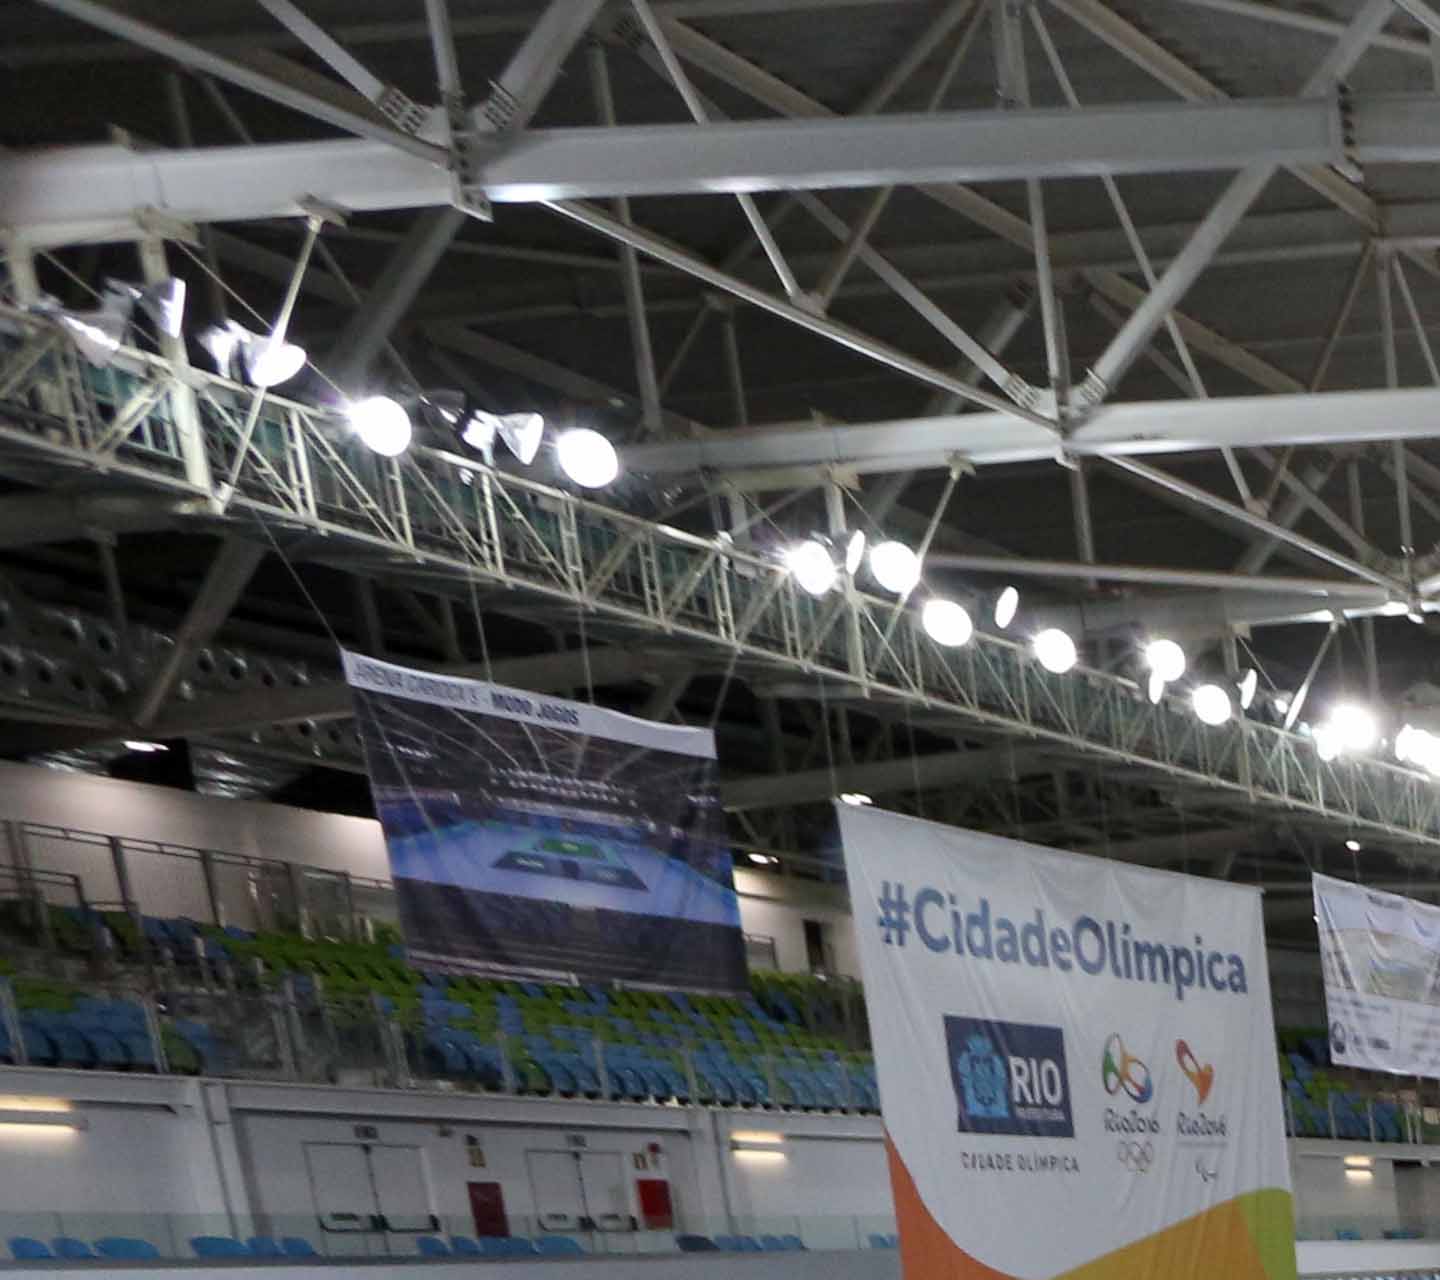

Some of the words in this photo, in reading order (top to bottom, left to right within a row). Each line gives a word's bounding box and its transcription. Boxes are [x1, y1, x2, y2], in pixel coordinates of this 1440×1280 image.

[877, 880, 1248, 1001] #CidadeOlímpica
[1007, 1055, 1063, 1106] RIO
[959, 1151, 1013, 1171] CIDADE
